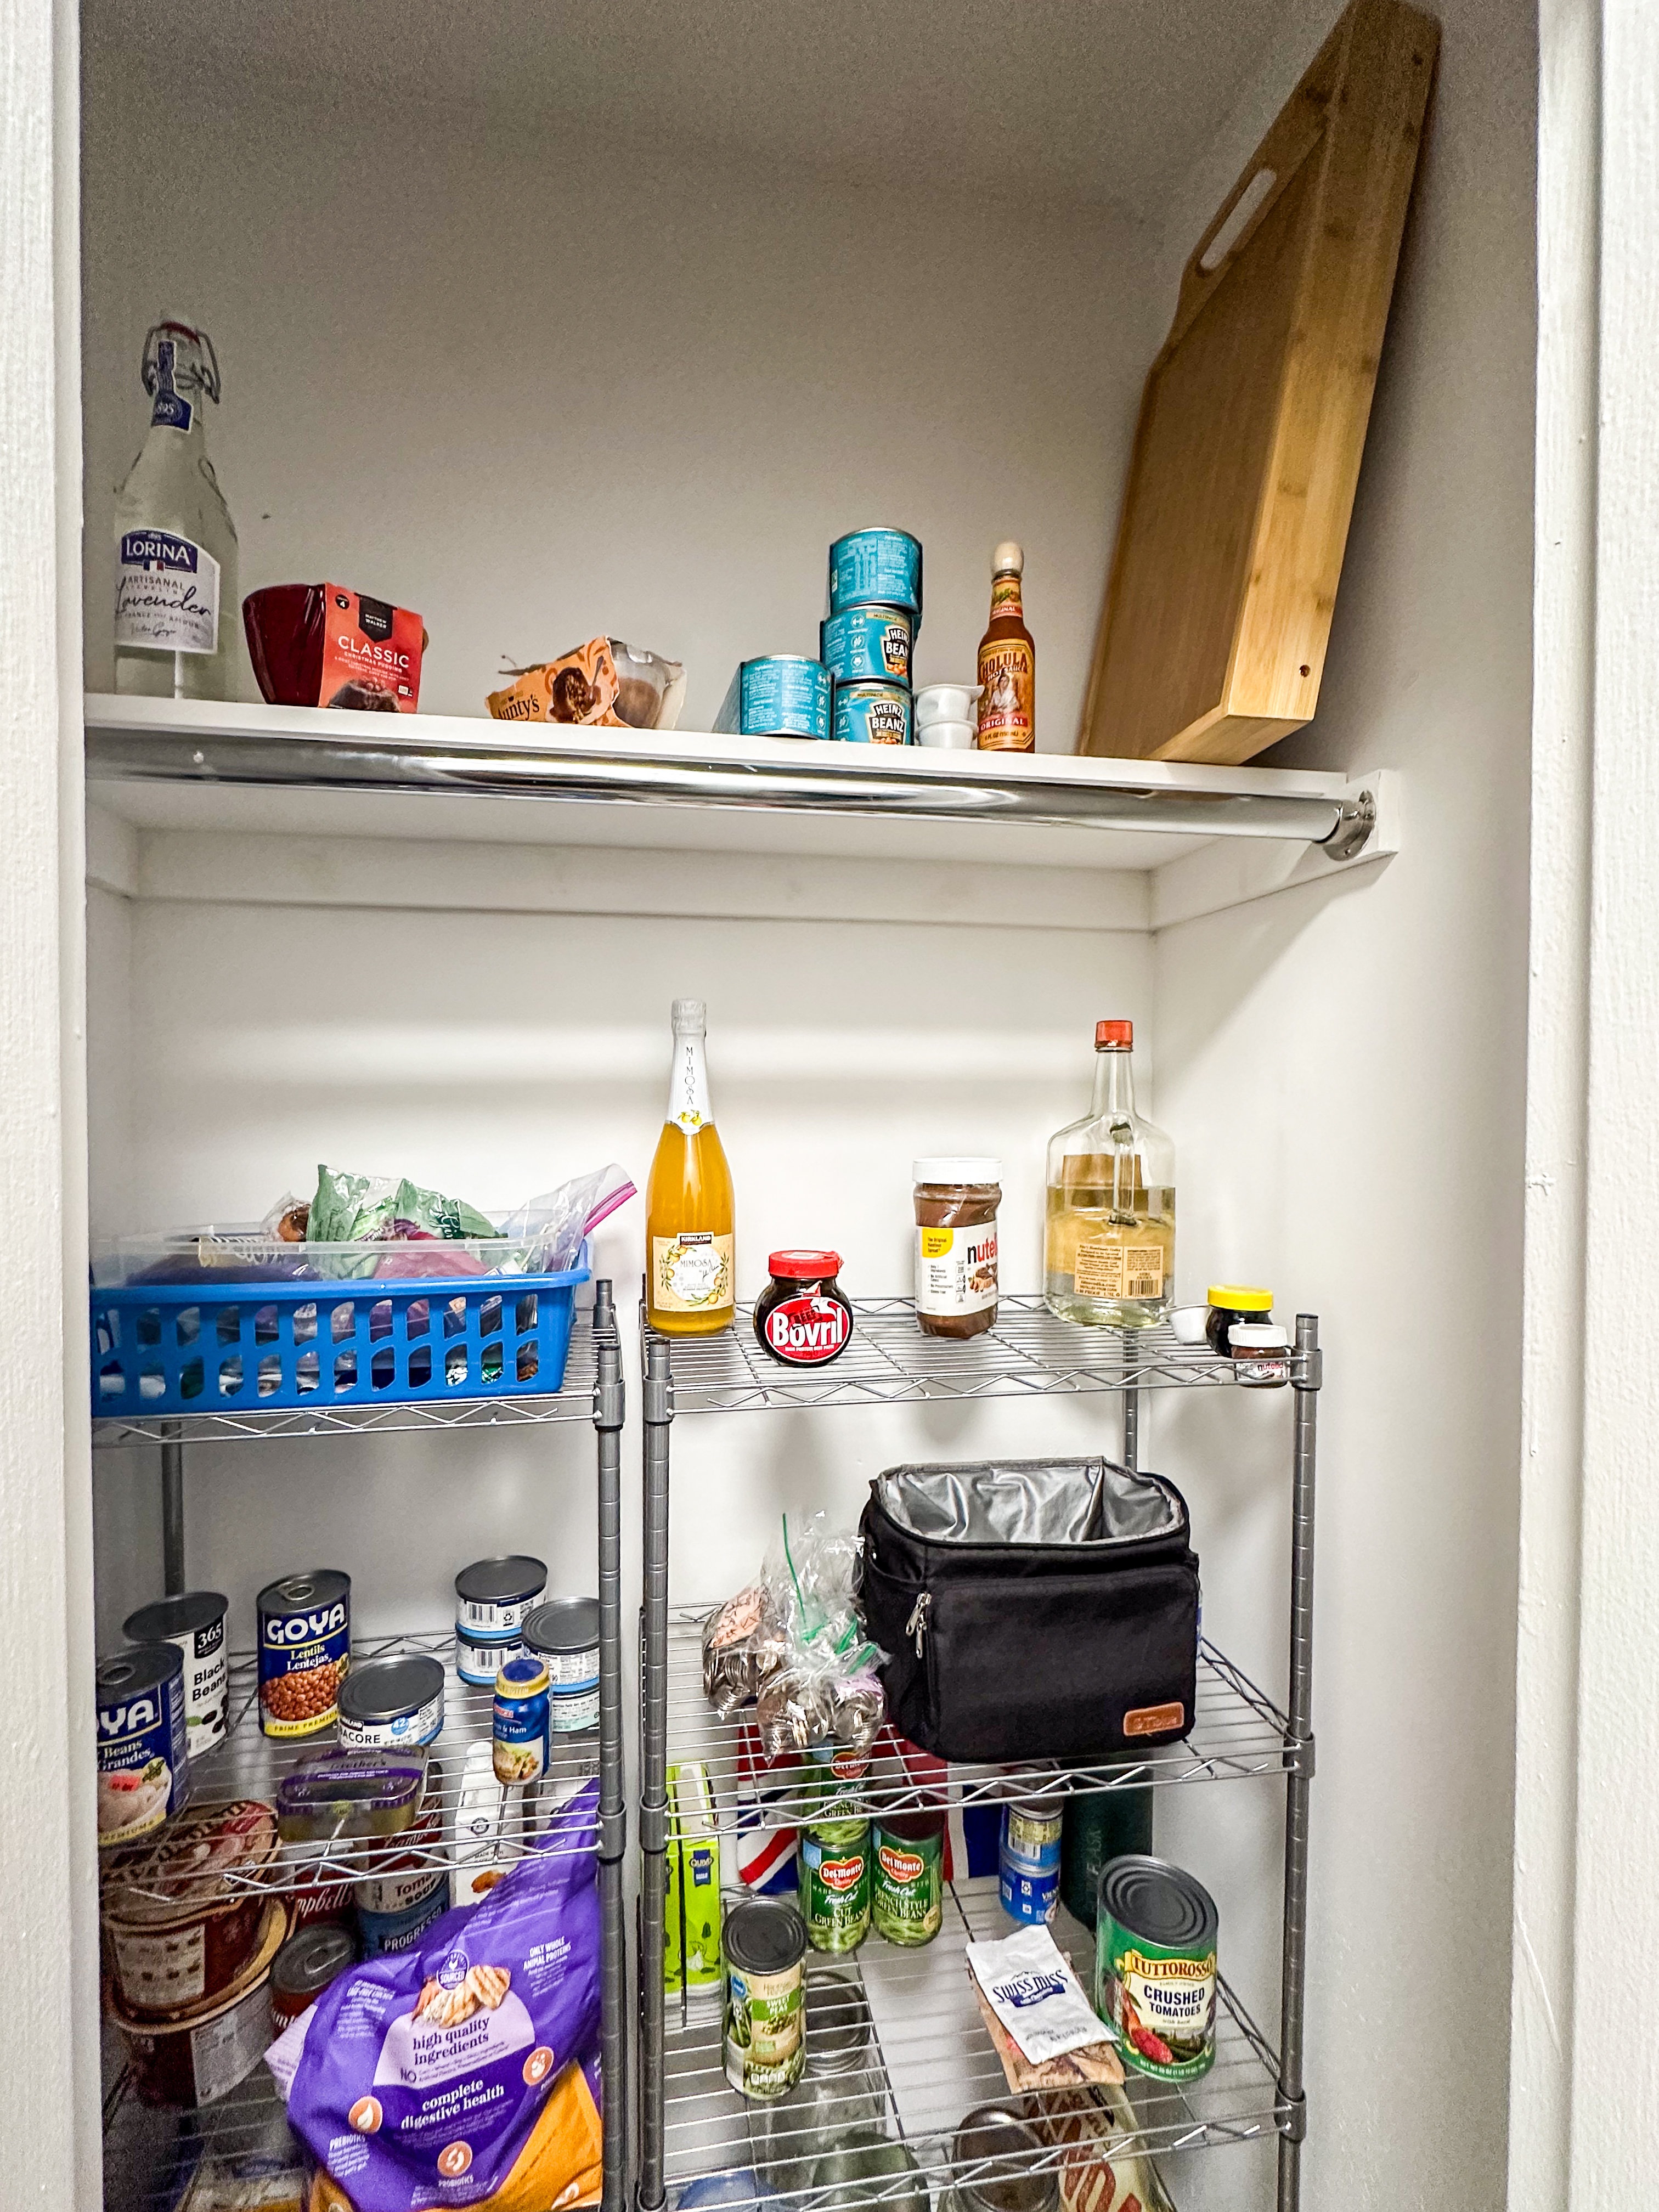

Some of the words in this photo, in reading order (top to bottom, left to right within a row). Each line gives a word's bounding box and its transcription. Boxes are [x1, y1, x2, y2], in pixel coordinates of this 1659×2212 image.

[126, 539, 190, 566] LORINA
[128, 575, 185, 591] ARTISANAL
[365, 618, 387, 629] WALKER
[890, 629, 909, 644] HEIN
[337, 635, 410, 668] CLASSIC
[377, 661, 403, 673] PUDDING
[979, 652, 1028, 684] CHOLULA
[876, 704, 902, 718] HEINZ
[872, 717, 904, 733] BEANZ
[980, 717, 1024, 731] ORIGINAL
[685, 1046, 695, 1105] MIMOSA
[967, 1232, 997, 1265] nutel
[680, 1259, 712, 1268] MIMOSA
[772, 1307, 843, 1347] Bovril
[267, 1603, 345, 1644] GOYA
[198, 1621, 222, 1649] 365
[290, 1644, 325, 1660] Lentils
[194, 1657, 224, 1686] Black
[193, 1672, 226, 1702] Beans
[99, 1700, 154, 1736] YA
[393, 1718, 406, 1728] 42
[341, 1729, 381, 1744] ACORE
[509, 1726, 527, 1734] Ham
[104, 1739, 143, 1759] Beans
[823, 1809, 853, 1818] GREEN
[881, 1850, 894, 1867] Del
[894, 1858, 921, 1872] Monte
[823, 1867, 838, 1878] Del
[838, 1863, 862, 1878] Monte
[394, 1872, 432, 1897] Toma
[882, 1879, 900, 1895] Fresh
[900, 1887, 917, 1897] Cut
[911, 1878, 929, 1888] WITH
[824, 1894, 845, 1904] Fresh
[844, 1890, 859, 1903] Cut
[1042, 1888, 1059, 1901] VIEN
[833, 1906, 853, 1918] CUT
[900, 1906, 927, 1919] BEANS
[904, 1898, 928, 1911] STYLE
[815, 1913, 843, 1928] GREEN
[529, 1944, 545, 1958] ONLY
[545, 1935, 565, 1953] WHOLE
[522, 1954, 546, 1971] ANIMAL
[1133, 1955, 1213, 1977] TUTTOROSSO
[439, 1970, 466, 1984] SOURCED
[992, 1978, 1034, 2004] SWISS
[1033, 1969, 1068, 1991] MISS
[1144, 1984, 1205, 2006] CRUSHED
[766, 1994, 790, 2006] SWEET
[769, 2005, 788, 2016] PEAS
[1149, 2001, 1201, 2018] TOMATOES
[413, 2032, 442, 2051] high
[445, 2017, 490, 2044] quality
[414, 2033, 489, 2066] ingredients
[400, 2067, 417, 2084] NO
[421, 2079, 484, 2112] complete
[400, 2103, 461, 2130] digestive
[462, 2084, 505, 2111] health
